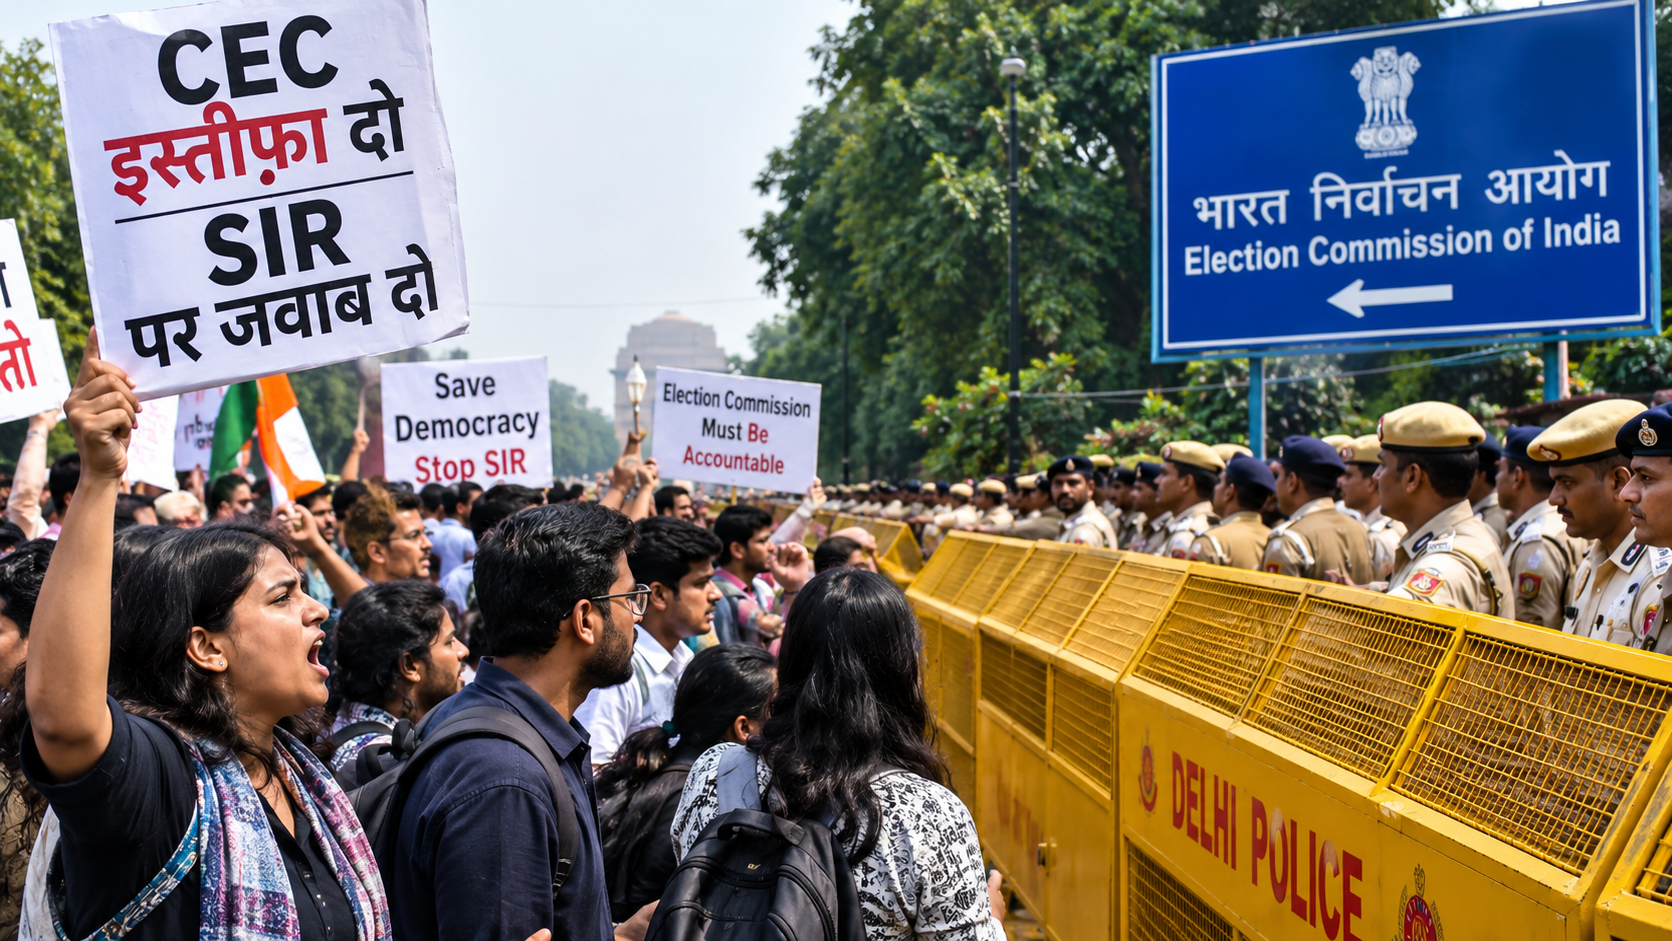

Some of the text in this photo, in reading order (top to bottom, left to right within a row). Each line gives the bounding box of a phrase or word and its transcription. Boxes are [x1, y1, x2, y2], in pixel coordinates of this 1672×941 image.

[158, 15, 338, 104] CEC
[104, 79, 404, 205] इस्तीफ़ा दो
[1193, 150, 1611, 230] भारत निर्वाचन आयोग
[204, 199, 350, 286] SIR
[1185, 213, 1620, 275] Election Commission of India
[124, 243, 438, 367] पर जवाब दो
[435, 372, 496, 399] Save
[664, 383, 811, 418] Election Commission
[396, 411, 539, 442] Democracy
[702, 417, 769, 444] Must Be
[415, 447, 527, 483] Stop SIR
[683, 445, 785, 475] Accountable
[1172, 751, 1237, 870] DELHI
[1251, 796, 1363, 941] POLICE
